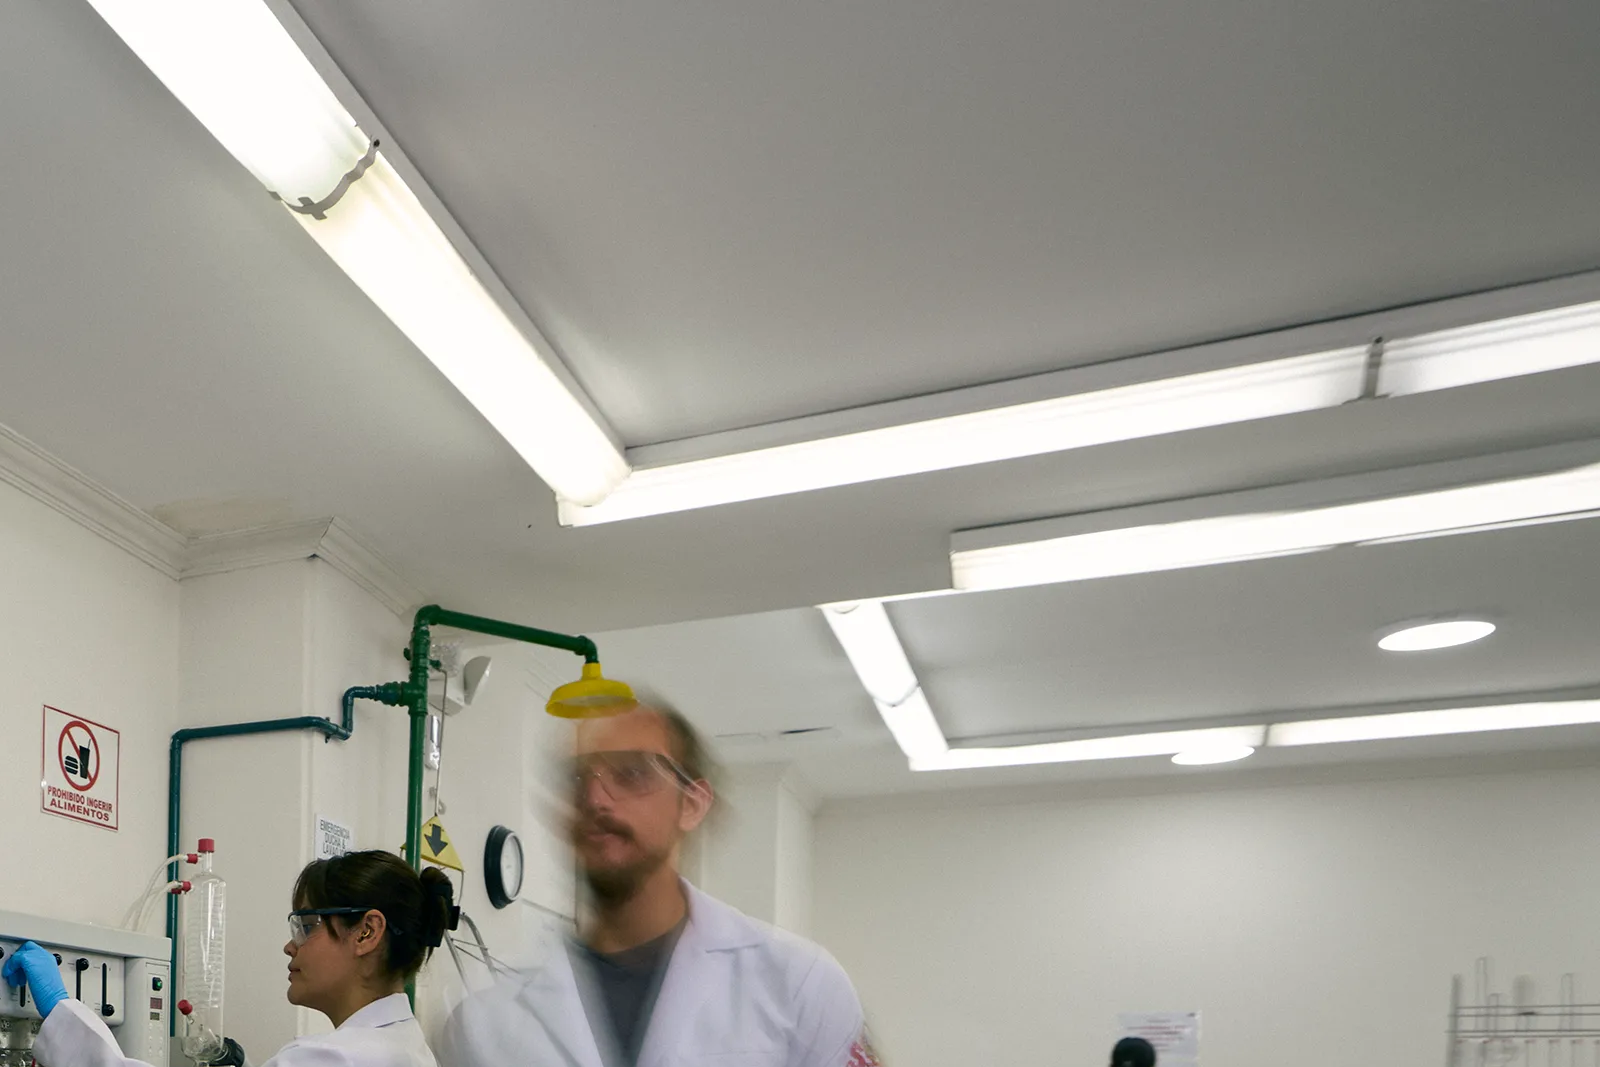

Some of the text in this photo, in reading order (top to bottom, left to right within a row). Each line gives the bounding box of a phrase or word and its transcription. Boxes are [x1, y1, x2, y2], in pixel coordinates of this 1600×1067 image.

[47, 785, 113, 813] PROHIBIDO INGERIR
[50, 798, 109, 821] ALIMENTOS
